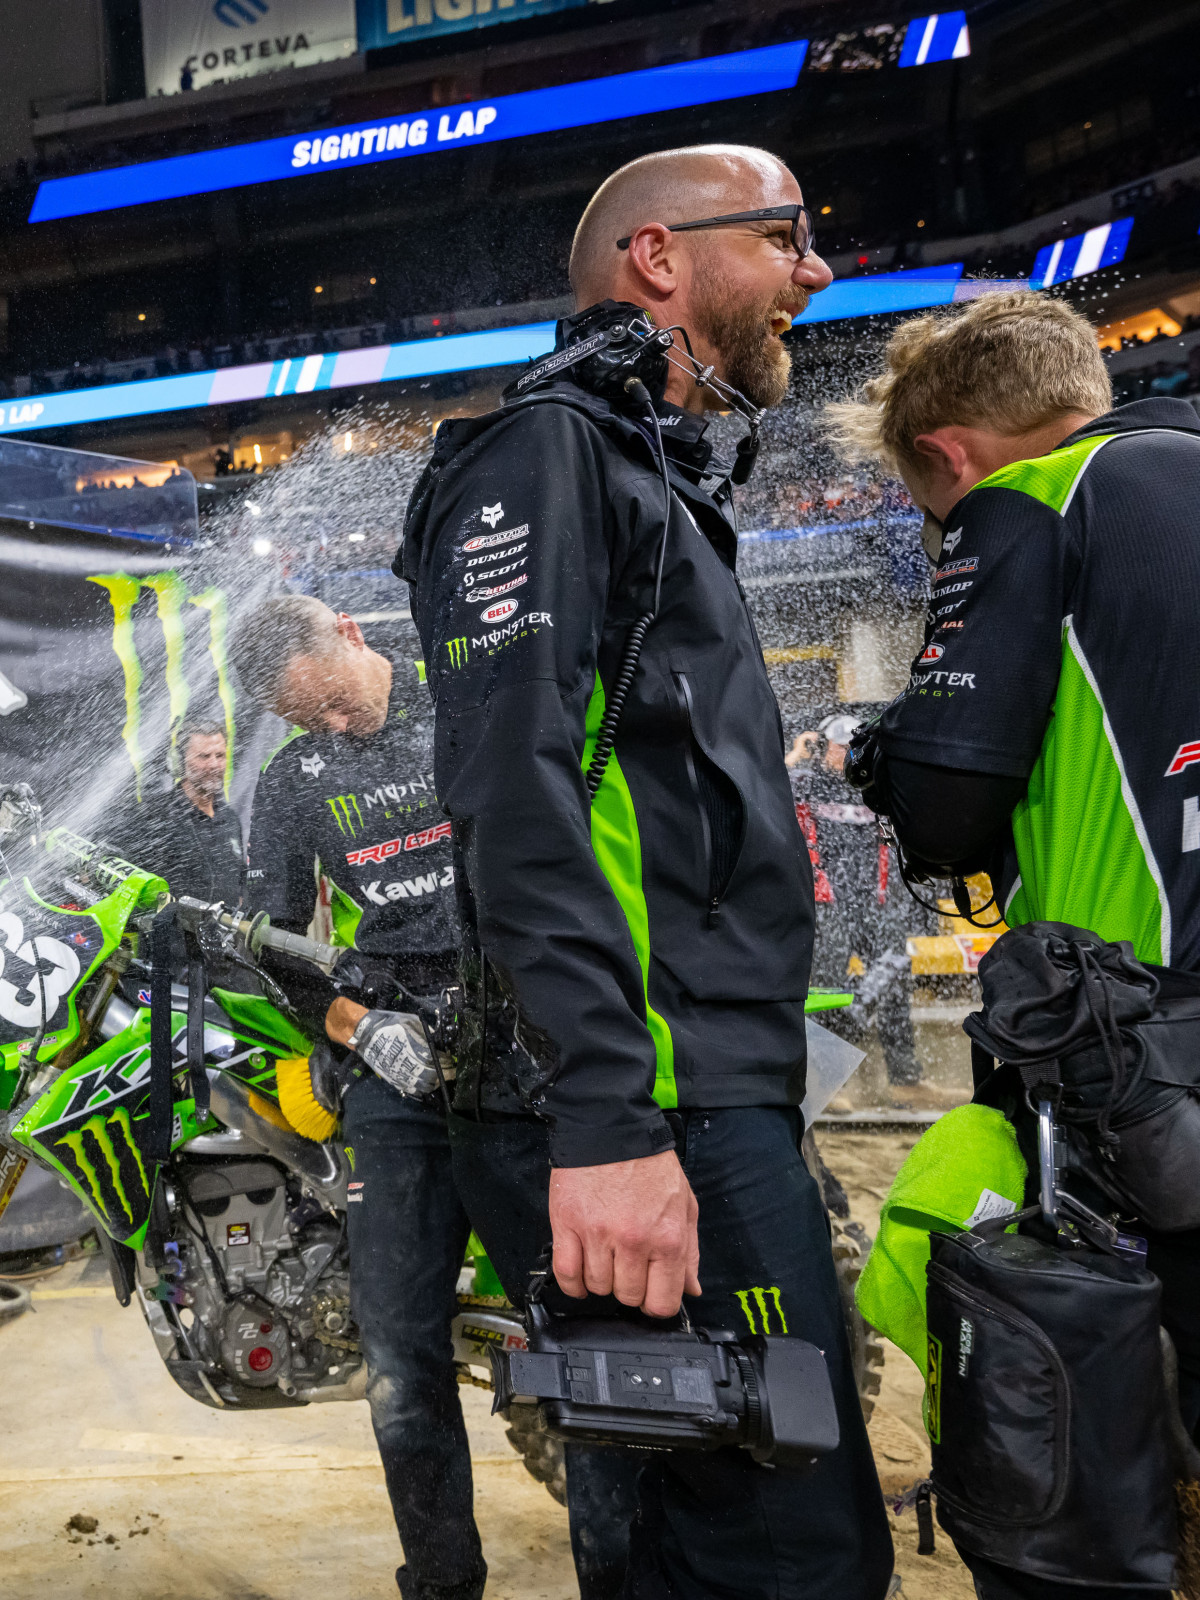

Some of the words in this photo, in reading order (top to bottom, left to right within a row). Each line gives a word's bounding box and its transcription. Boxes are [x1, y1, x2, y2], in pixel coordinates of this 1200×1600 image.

[185, 33, 310, 73] CORTEVA
[291, 118, 429, 168] SIGHTING
[437, 106, 498, 143] LAP
[9, 403, 44, 424] LAP
[466, 542, 527, 567] DUNLOP
[477, 557, 528, 581] SCOTT
[486, 573, 528, 596] RENTHAL
[931, 581, 973, 600] UNLOP
[487, 603, 513, 620] BELL
[472, 611, 554, 649] MONSTER
[489, 628, 540, 656] ENERGY
[346, 838, 401, 866] PRO
